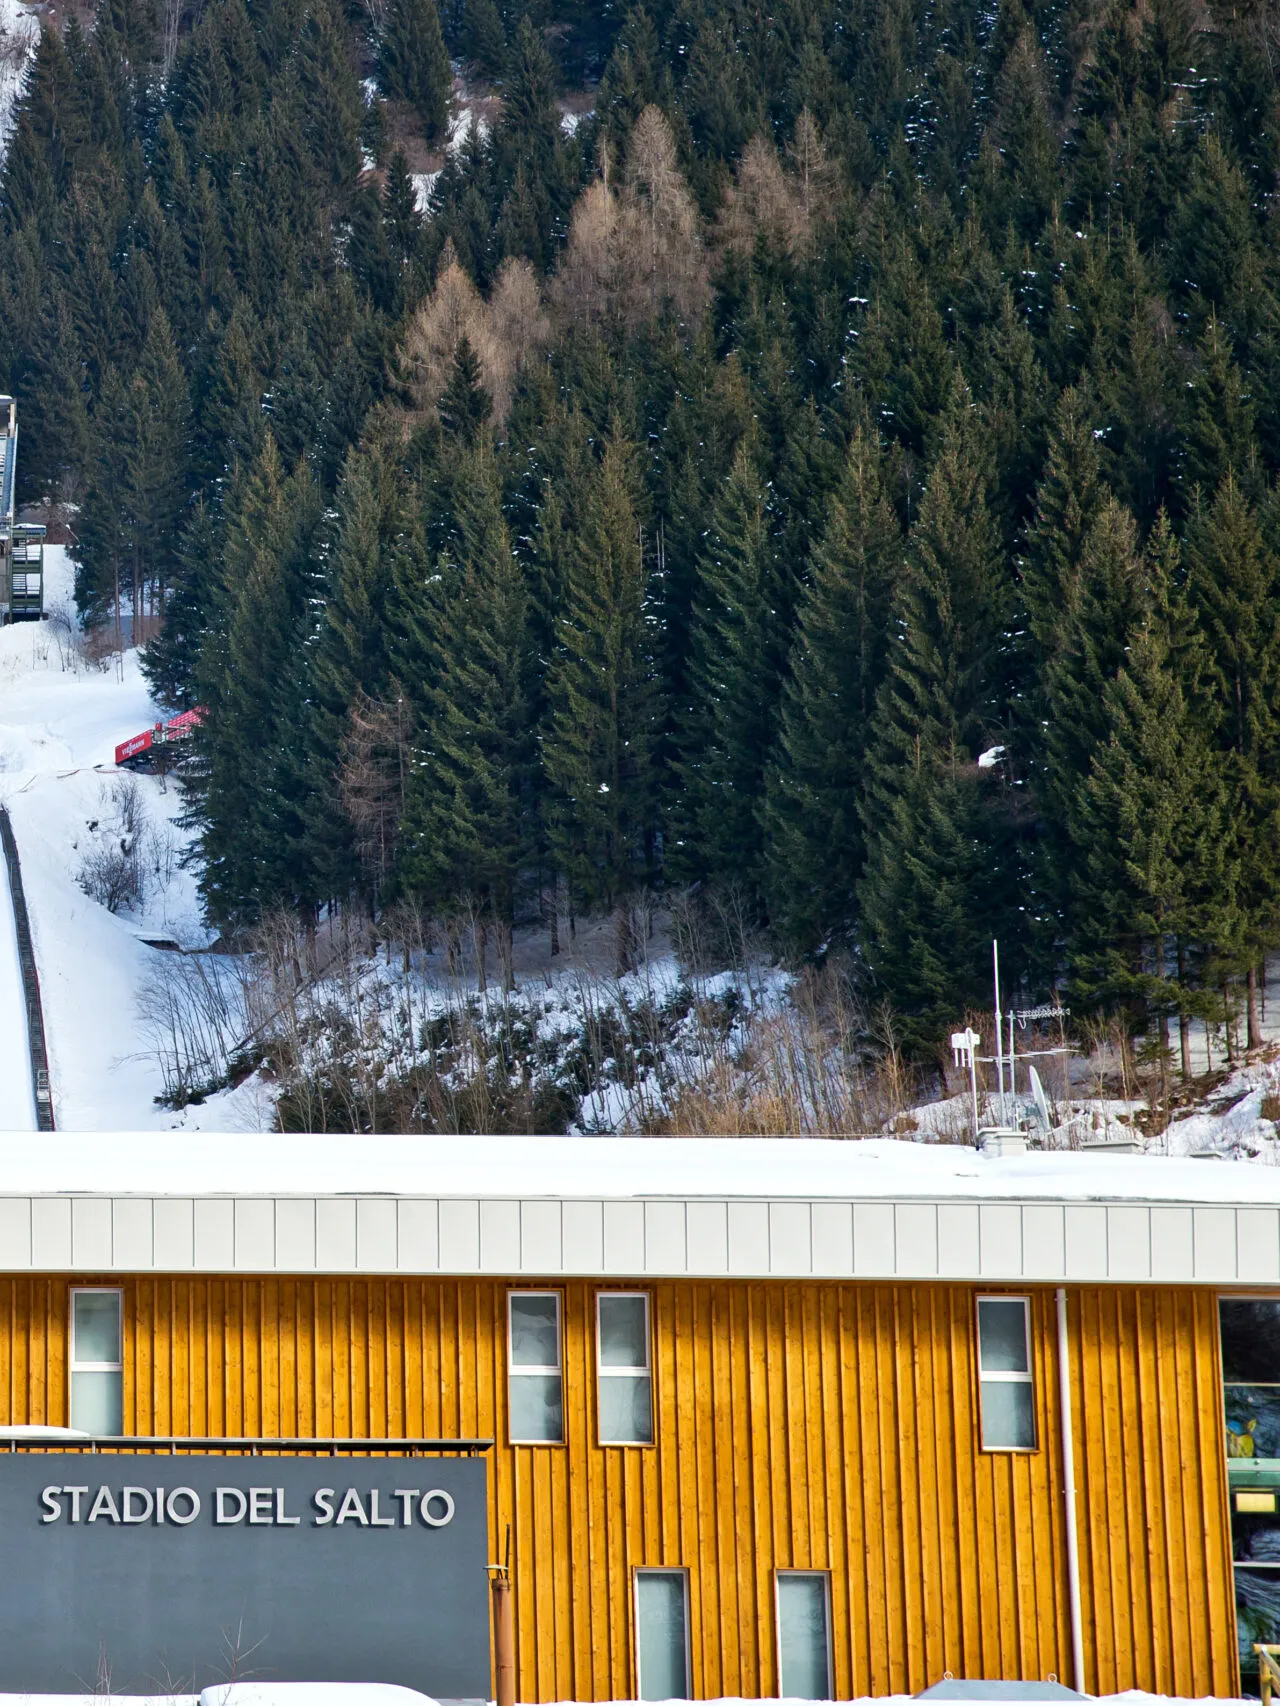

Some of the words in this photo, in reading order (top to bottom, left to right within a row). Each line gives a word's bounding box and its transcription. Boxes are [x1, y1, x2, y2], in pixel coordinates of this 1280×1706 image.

[41, 1485, 201, 1525] STADIO
[216, 1487, 300, 1525] DEL
[314, 1487, 456, 1527] SALTO
